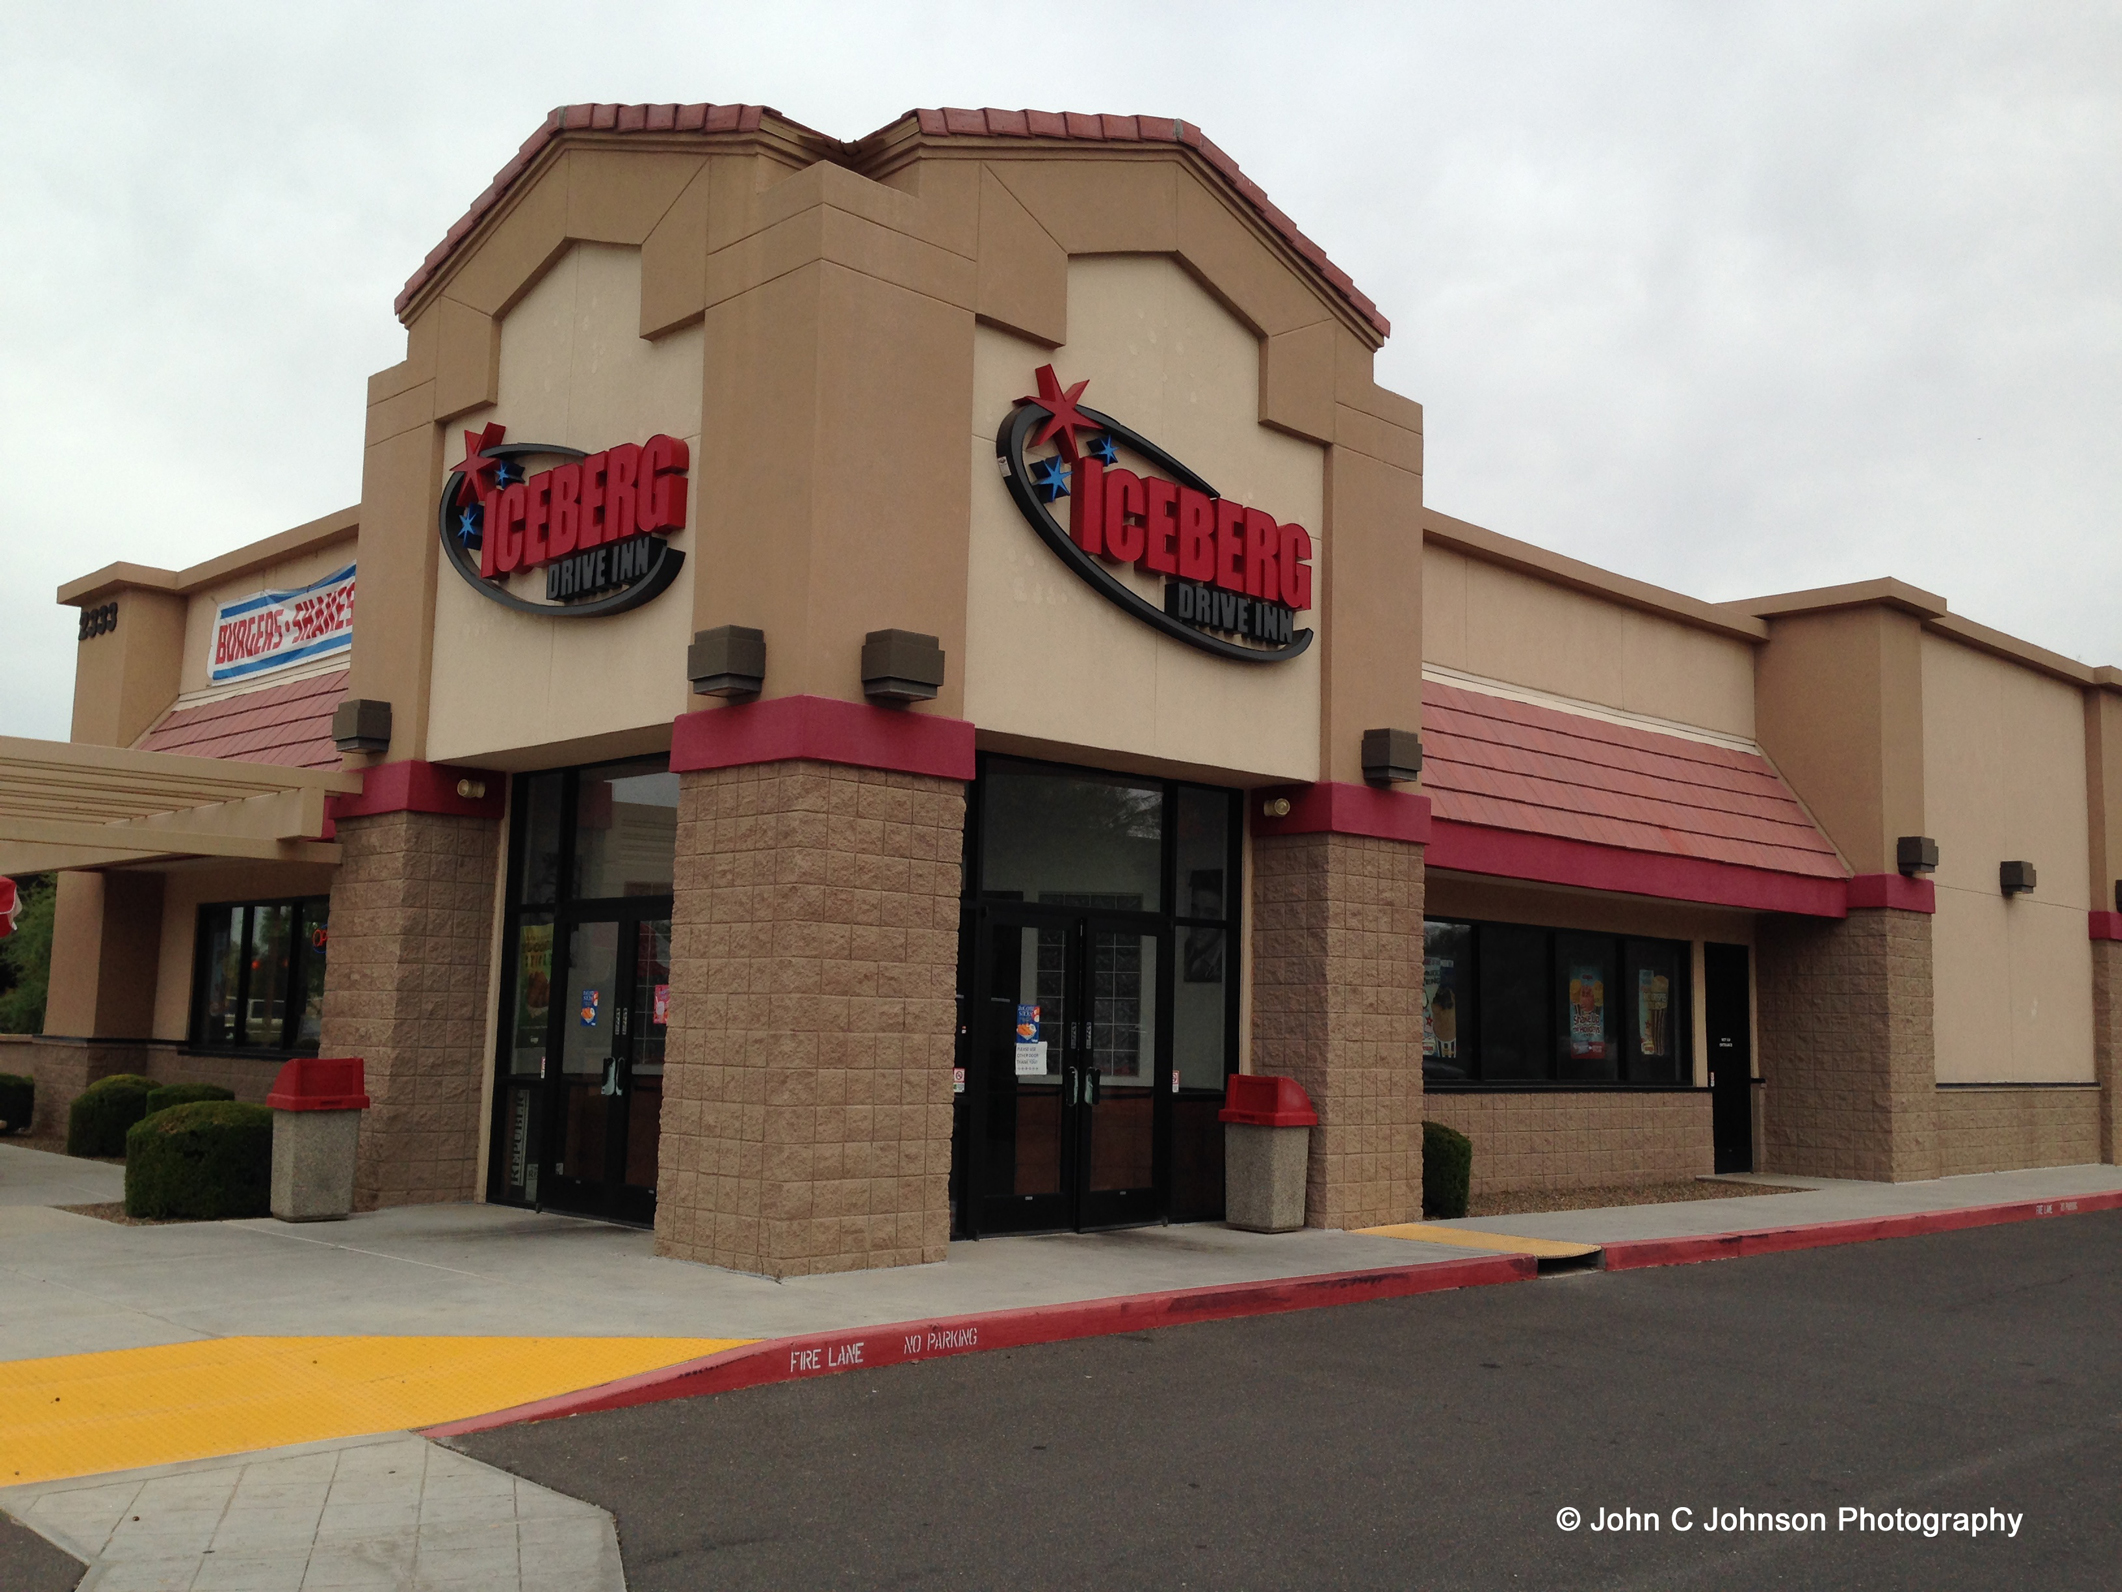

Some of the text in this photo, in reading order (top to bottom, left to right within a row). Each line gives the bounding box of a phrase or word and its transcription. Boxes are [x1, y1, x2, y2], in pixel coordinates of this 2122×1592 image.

[481, 434, 689, 580] ICEBERG
[1070, 456, 1312, 612] ICEBERG
[547, 537, 653, 600] DRIVE INN
[78, 602, 118, 640] 2333
[215, 609, 284, 665] BURGERS
[1174, 583, 1294, 644] DRIVE INN
[790, 1342, 864, 1372] FIRE LANE
[904, 1328, 978, 1354] NO PARKING
